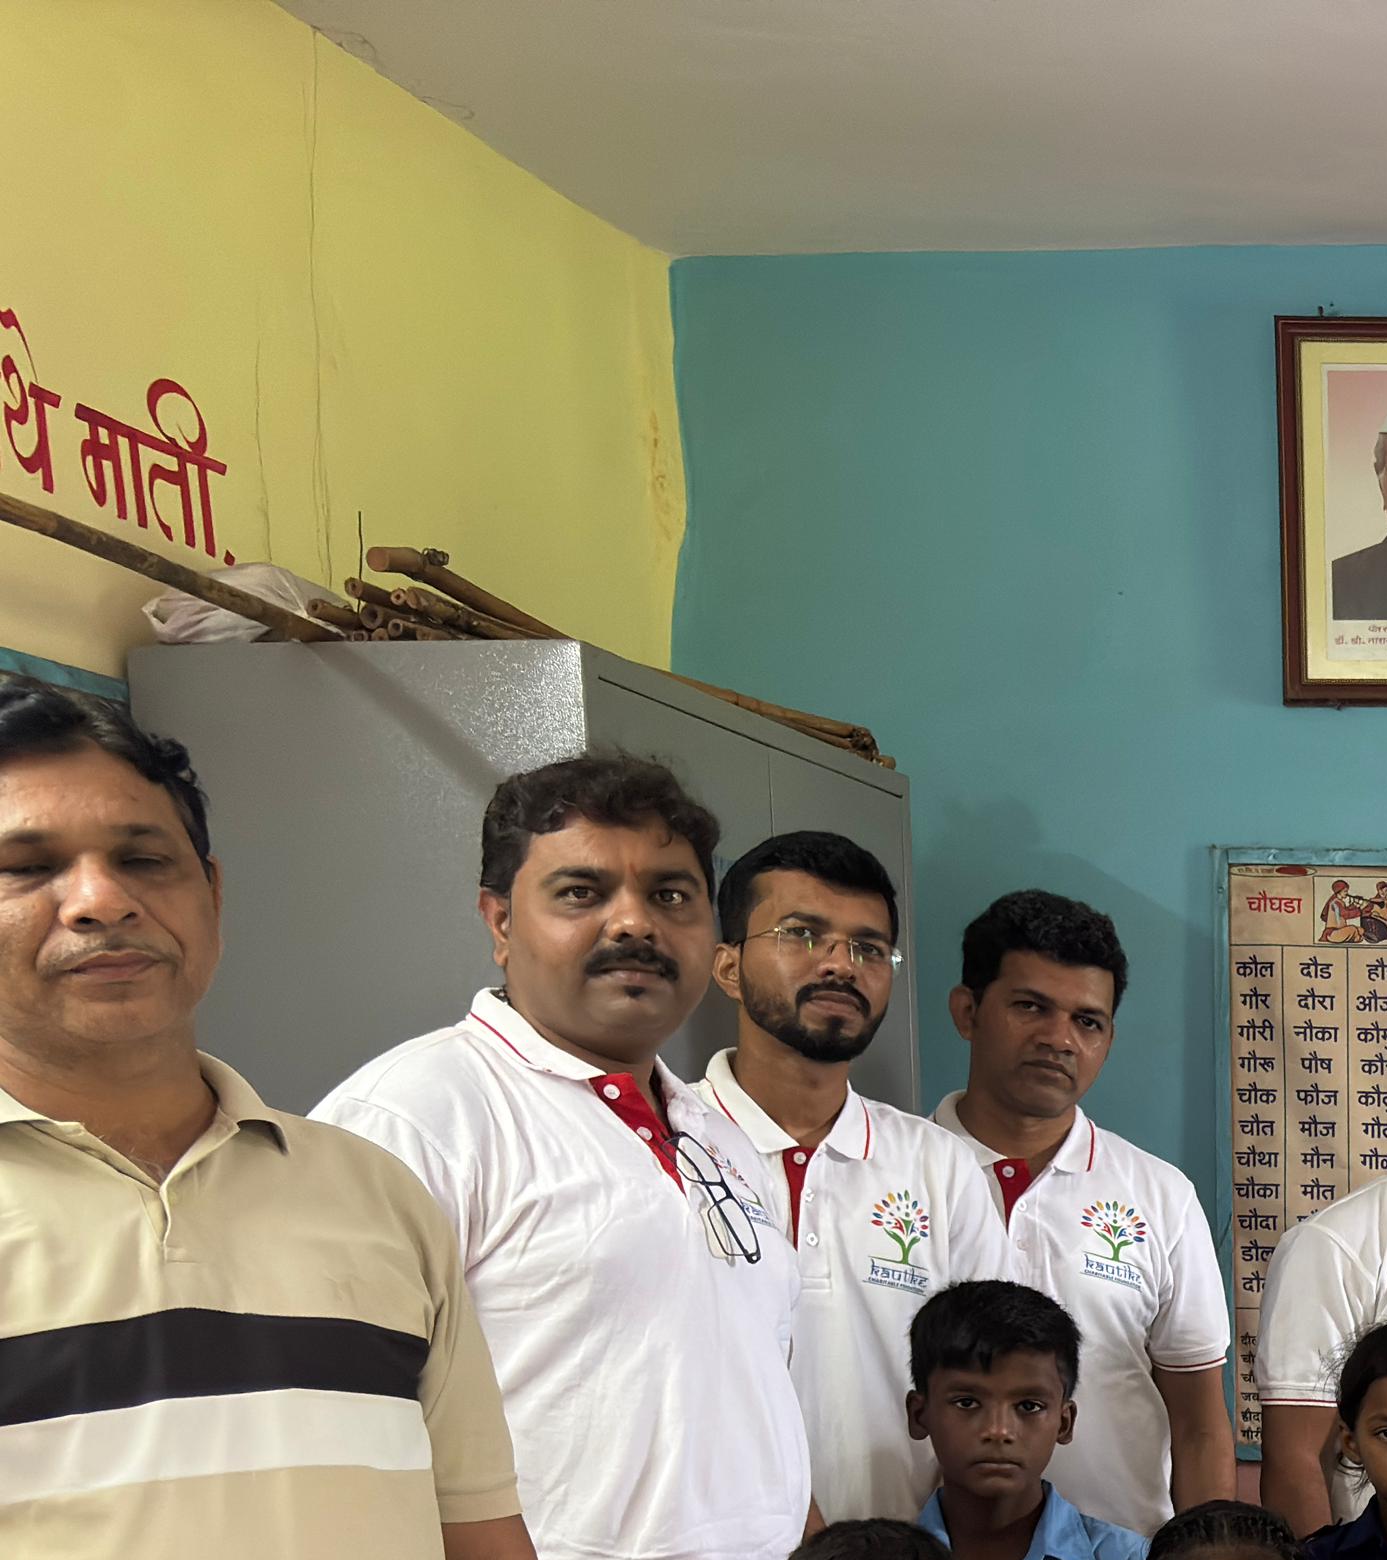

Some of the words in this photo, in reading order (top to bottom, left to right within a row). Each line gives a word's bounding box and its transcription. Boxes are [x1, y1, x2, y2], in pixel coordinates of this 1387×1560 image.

[75, 378, 236, 566] माती.
[1246, 890, 1303, 914] चौघडा
[1235, 954, 1275, 978] कौल
[1299, 956, 1334, 980] दौड
[1240, 987, 1271, 1010] गौर
[1297, 988, 1335, 1011] दौरा
[1237, 1018, 1274, 1041] गौरी
[1293, 1019, 1339, 1043] नौका
[1238, 1049, 1275, 1073] गौरू
[1300, 1051, 1333, 1074] पौष
[1236, 1082, 1277, 1105] चौक
[1296, 1083, 1339, 1106] फौज
[1238, 1113, 1275, 1136] चौत
[1299, 1114, 1337, 1138] मौज
[1235, 1145, 1279, 1169] चौथा
[1300, 1146, 1335, 1169] मौन
[1234, 1176, 1280, 1200] चौका
[1300, 1177, 1335, 1201] मौत
[1237, 1208, 1277, 1231] चौदा
